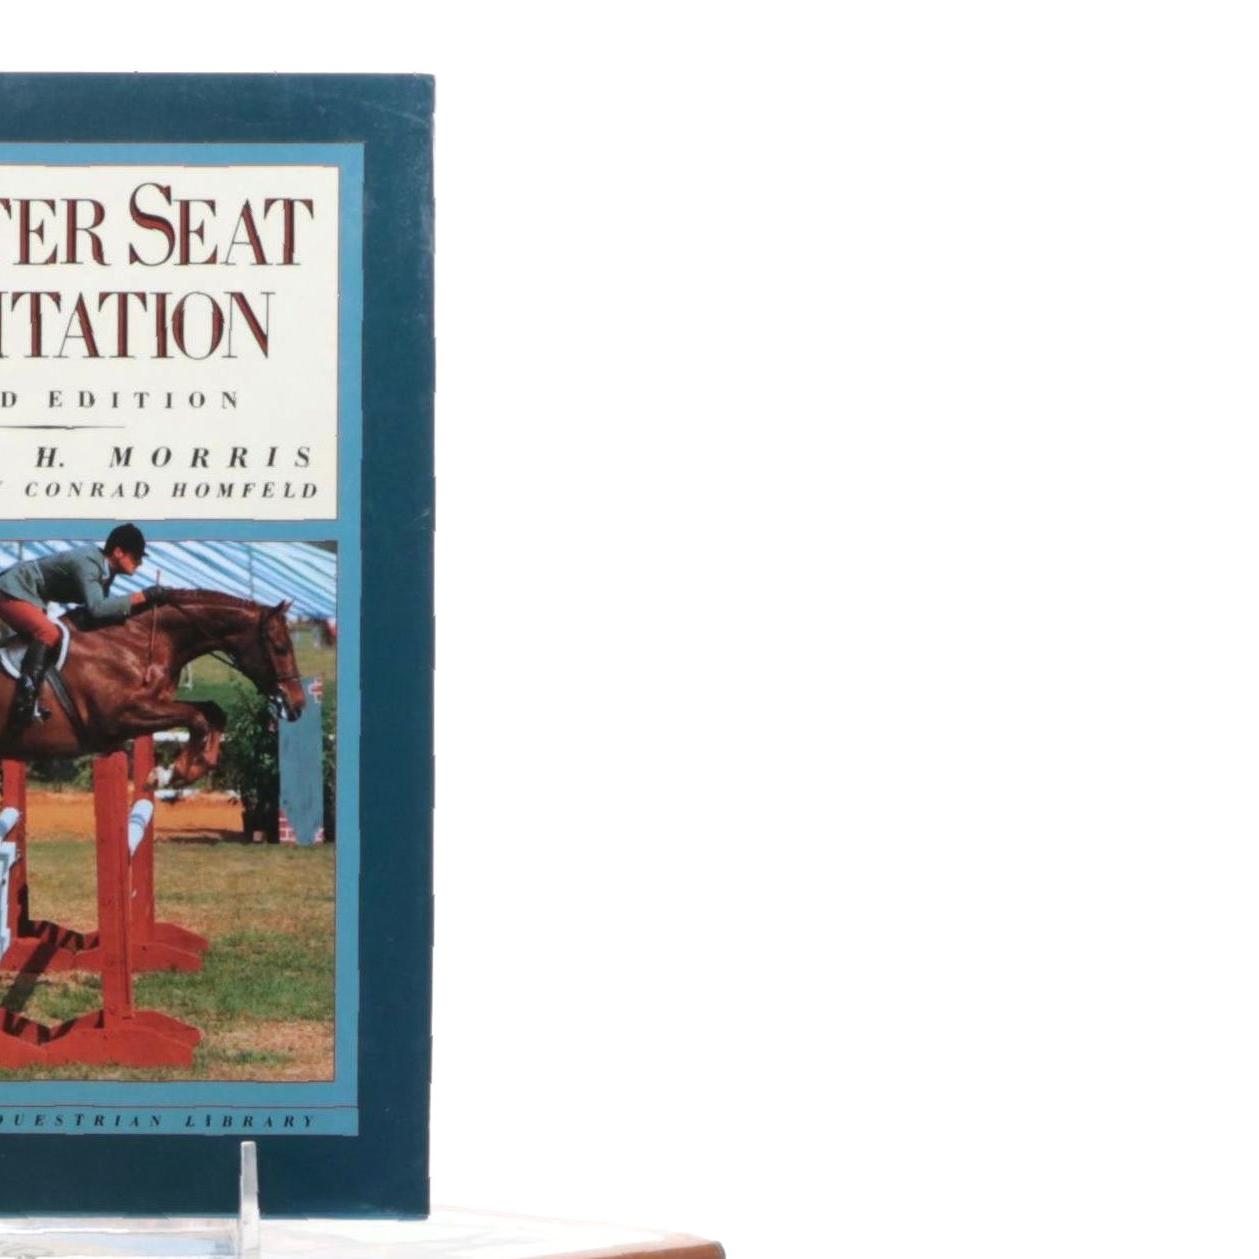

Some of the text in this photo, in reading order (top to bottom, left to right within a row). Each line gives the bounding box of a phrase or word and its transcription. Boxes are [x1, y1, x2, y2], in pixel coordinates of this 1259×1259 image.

[128, 182, 315, 266] SEAT
[48, 390, 239, 409] EDITION
[36, 447, 65, 468] H.
[109, 446, 311, 467] MORRIS
[25, 480, 151, 498] CONRAD
[171, 481, 318, 498] HOMFELD
[185, 1112, 316, 1128] LIBRARY
